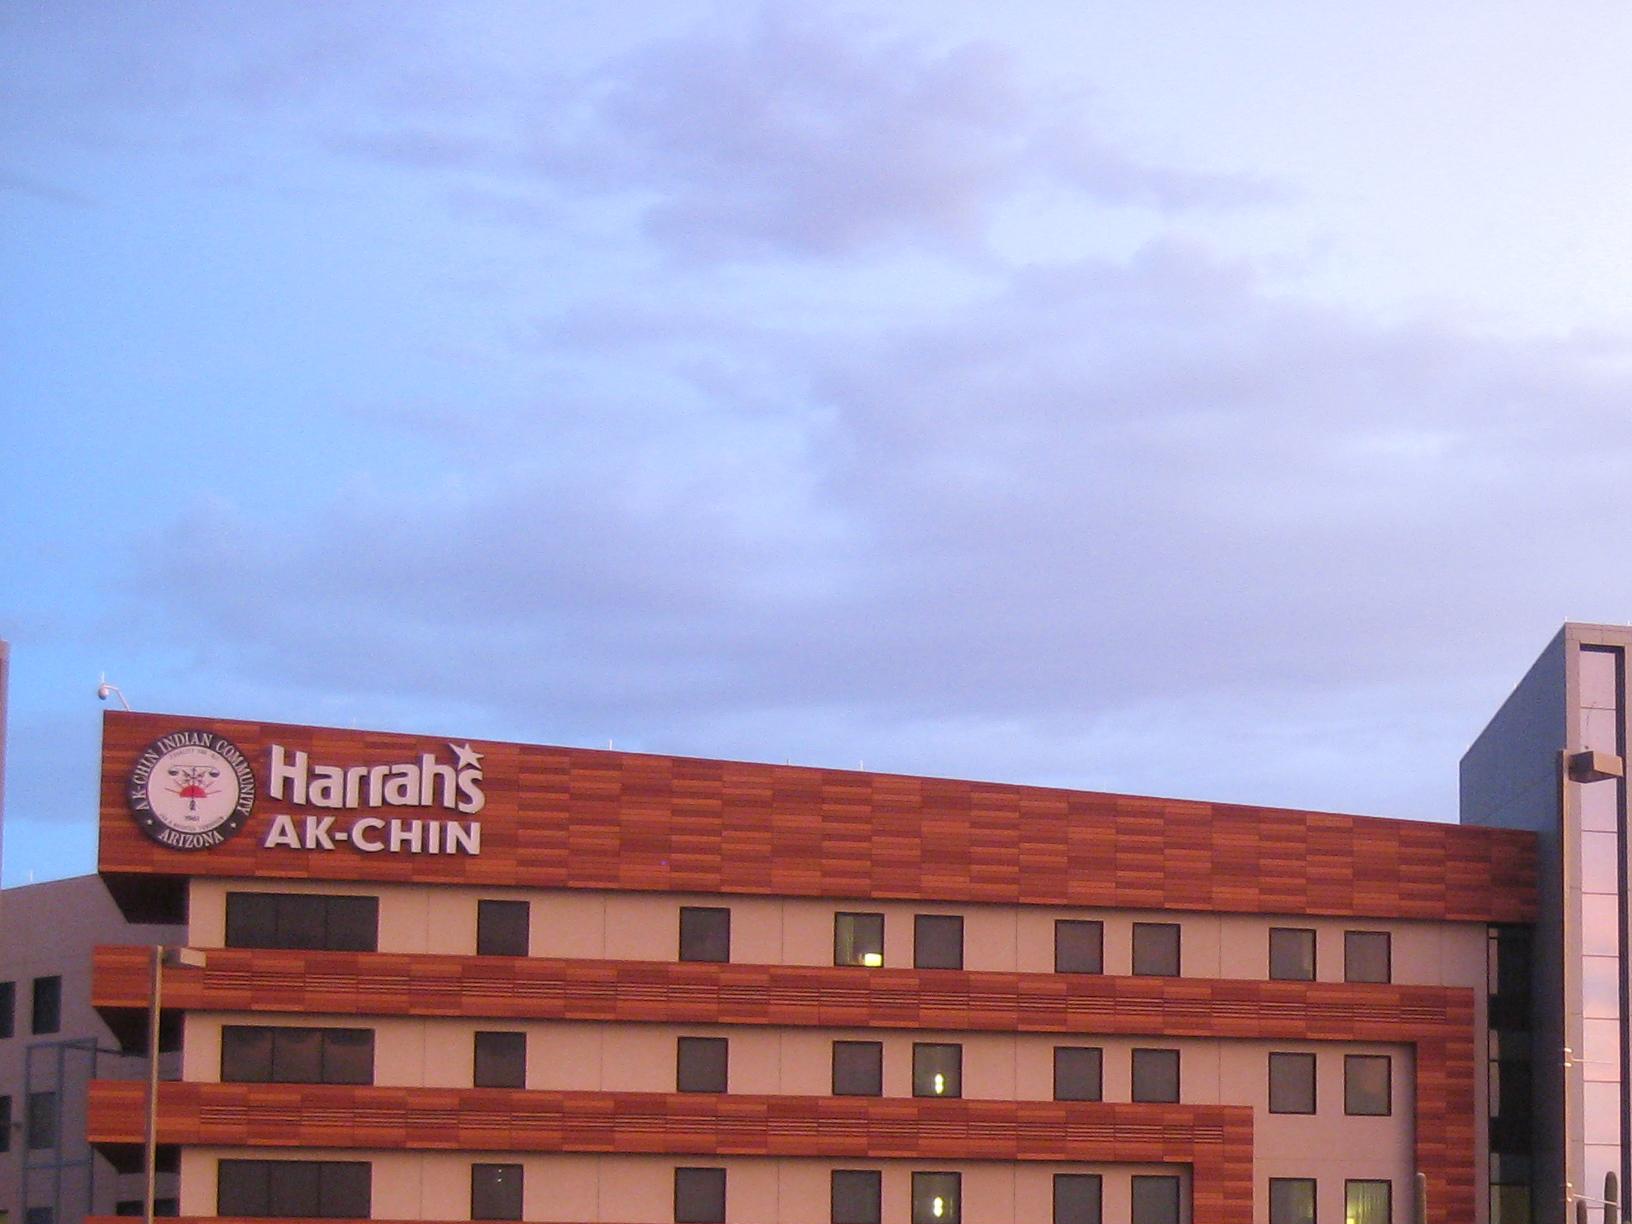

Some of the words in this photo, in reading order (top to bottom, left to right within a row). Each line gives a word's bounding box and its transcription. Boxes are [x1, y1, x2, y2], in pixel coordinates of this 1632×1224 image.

[132, 748, 160, 811] AK-CHIN
[157, 732, 214, 754] INDIAN
[215, 740, 256, 816] COMMUNITY
[159, 830, 225, 848] ARIZONA
[264, 814, 482, 855] AK-CHIN
